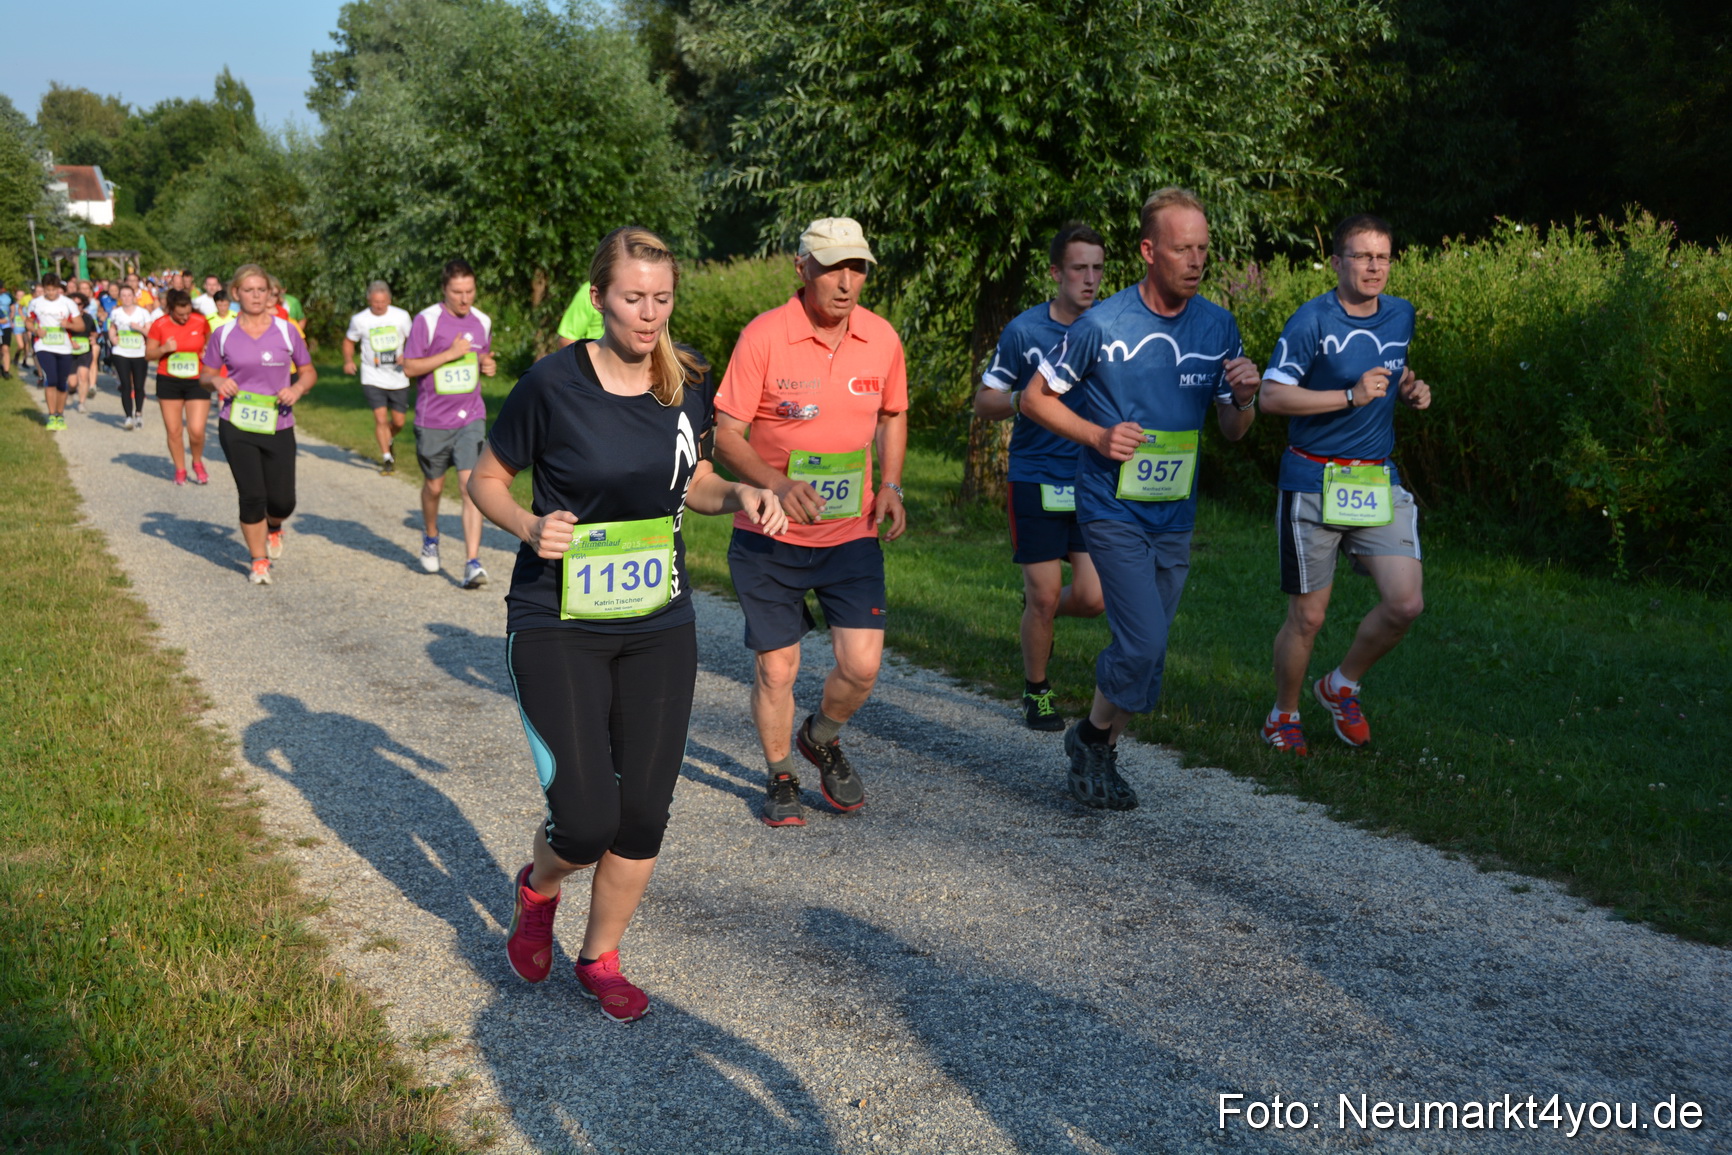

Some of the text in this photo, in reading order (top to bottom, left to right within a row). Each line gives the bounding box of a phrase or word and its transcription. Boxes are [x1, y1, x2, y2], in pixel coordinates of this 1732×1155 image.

[444, 369, 471, 383] 513
[851, 377, 880, 393] GTÜ
[240, 408, 268, 422] 515
[1137, 460, 1184, 482] 957
[1336, 488, 1378, 510] 954
[576, 558, 662, 595] 1130
